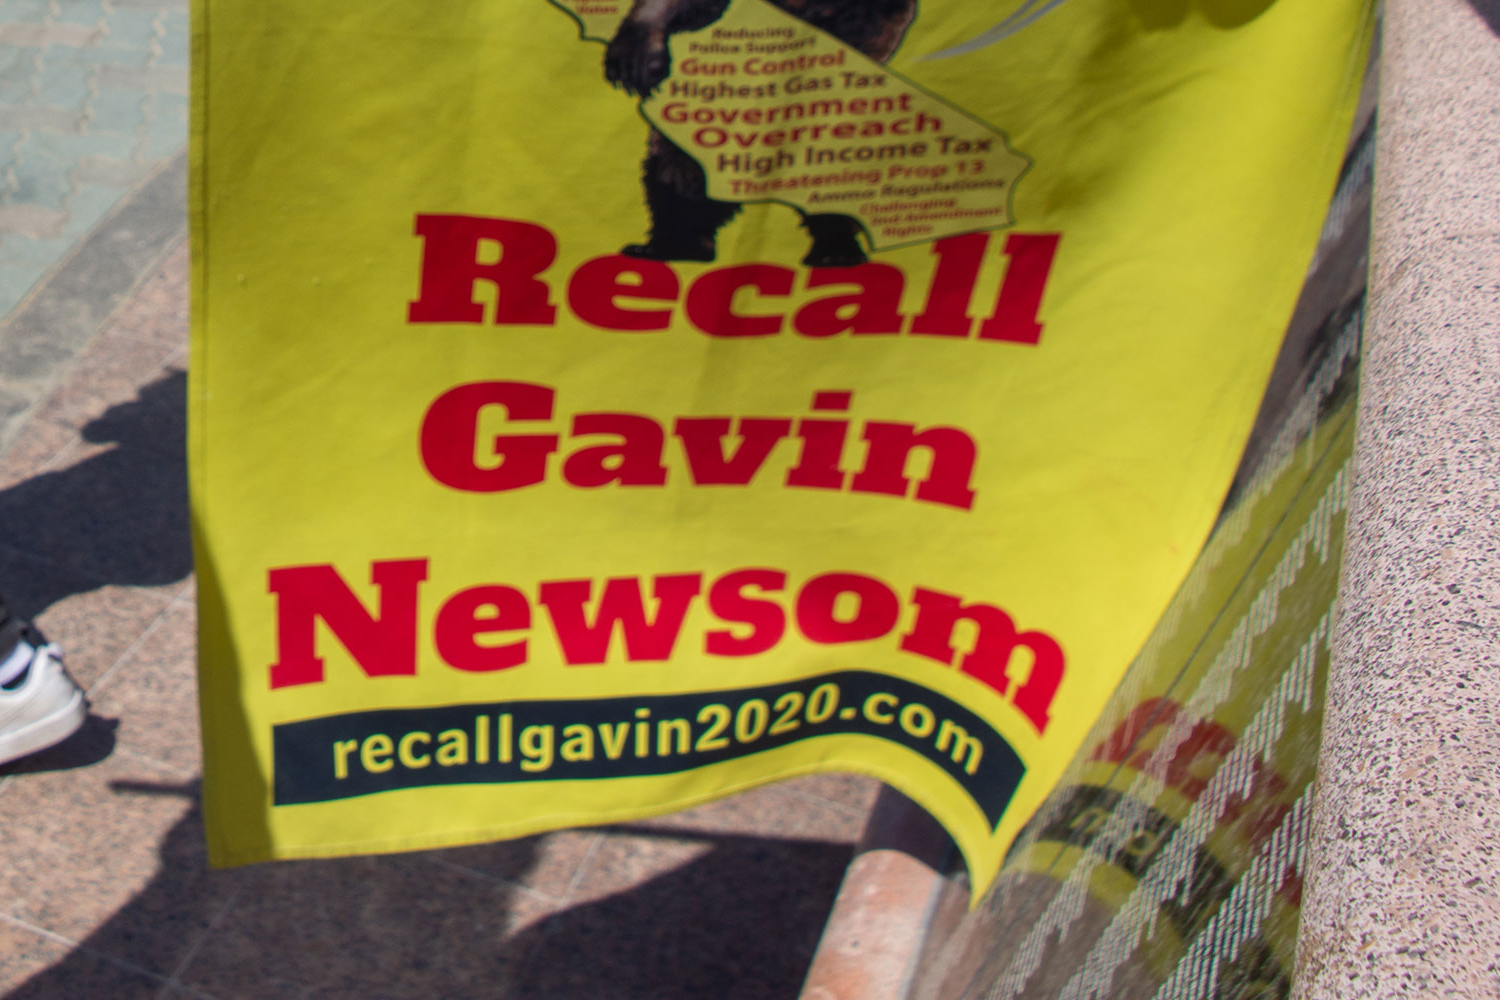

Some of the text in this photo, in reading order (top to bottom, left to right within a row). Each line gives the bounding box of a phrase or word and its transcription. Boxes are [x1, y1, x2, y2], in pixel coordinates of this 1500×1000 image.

[689, 35, 817, 54] Police Support
[711, 26, 796, 41] Reducing
[679, 48, 846, 76] Gun Control
[668, 71, 887, 101] Highest Gas Tax
[660, 91, 913, 125] Government
[692, 111, 943, 148] Overreach
[716, 135, 995, 175] High Income Tax
[728, 159, 985, 195] Threatening Prop 13
[807, 177, 1006, 204] Ammo Regulations
[406, 212, 1063, 347] Recall
[418, 380, 979, 511] Gavin
[267, 557, 1067, 739] Newsom
[332, 682, 986, 779] recallgavin2020.com
